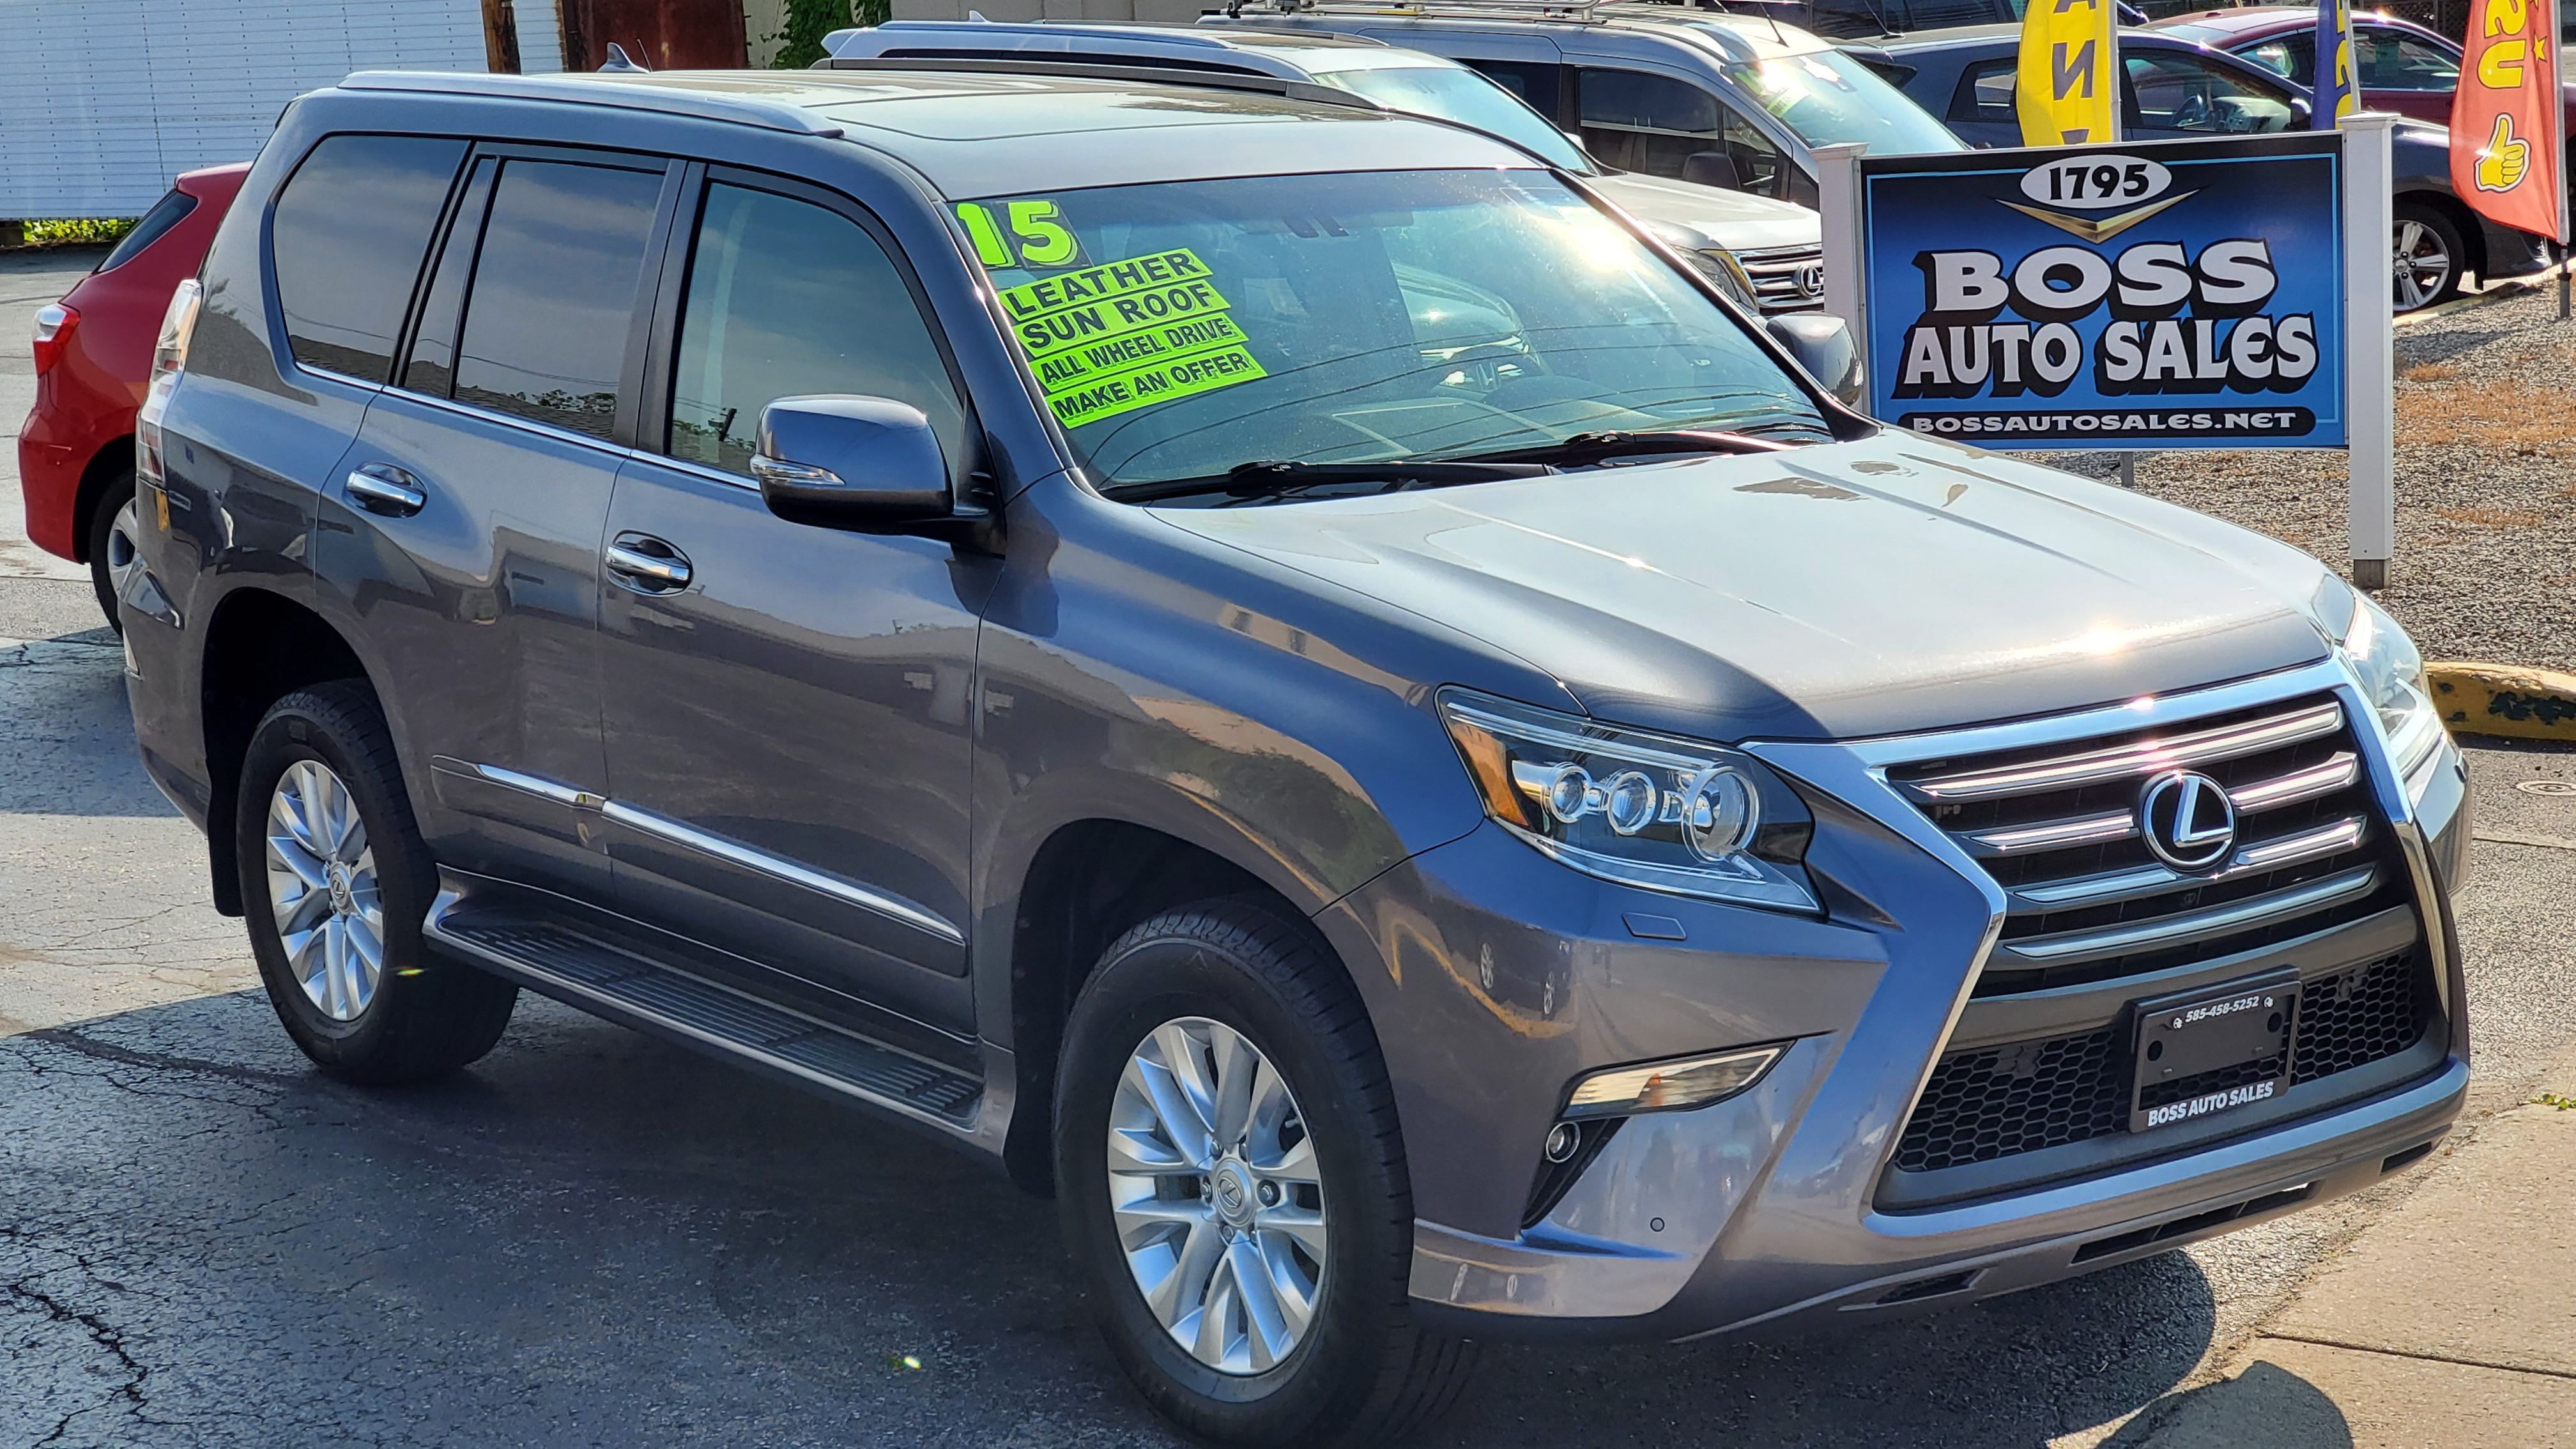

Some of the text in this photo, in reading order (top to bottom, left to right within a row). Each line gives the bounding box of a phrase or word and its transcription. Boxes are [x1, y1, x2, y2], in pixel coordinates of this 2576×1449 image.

[2048, 163, 2149, 201] 1795
[957, 201, 1078, 267] 15
[1007, 252, 1201, 316] LEATHER
[1927, 239, 2278, 314] BOSS
[1022, 281, 1215, 349] SUN ROOF
[1041, 318, 1234, 385] ALL WHEEL DRIVE
[1903, 314, 2319, 386] AUTO SALES
[1054, 352, 1250, 420] MAKE AN OFFER
[1913, 413, 2296, 433] BOSSAUTOSALES.NET
[2185, 995, 2259, 1023] 585-458-5252
[2147, 1082, 2274, 1127] BOSS AUTO SALES
